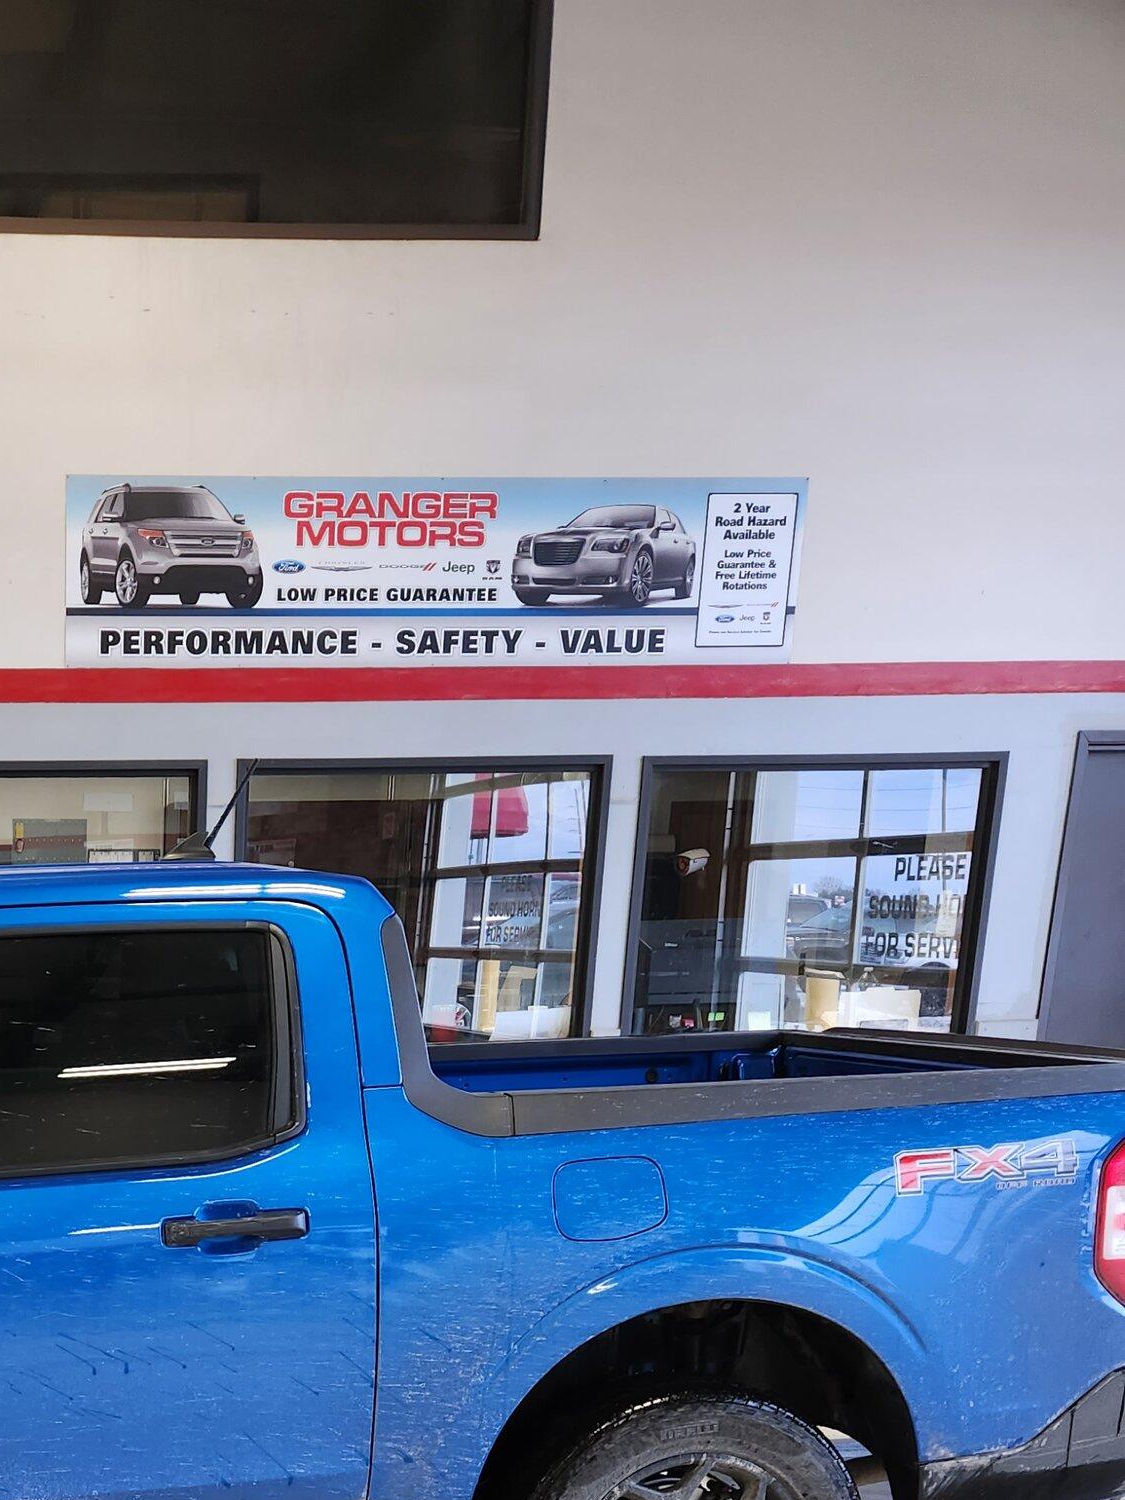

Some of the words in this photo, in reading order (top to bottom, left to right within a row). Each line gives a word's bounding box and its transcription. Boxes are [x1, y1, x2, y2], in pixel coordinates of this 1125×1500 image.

[283, 491, 498, 519] GRANGER
[733, 502, 742, 514] 2
[746, 502, 771, 514] Year
[715, 516, 744, 527] Road
[747, 516, 787, 527] Hazard
[296, 520, 485, 547] MOTORS
[723, 529, 776, 540] Available
[724, 549, 745, 558] Low
[747, 549, 772, 558] Price
[442, 561, 475, 575] Jeep
[717, 560, 765, 569] Guarantee
[768, 560, 777, 569] &
[715, 570, 735, 580] Free
[738, 570, 777, 580] Lifetime
[722, 581, 768, 591] Rotations
[276, 587, 317, 601] LOW
[325, 587, 379, 601] PRICE
[386, 587, 498, 601] GUARANTEE
[100, 630, 358, 655] PERFORMANCE
[396, 629, 523, 654] SAFETY
[560, 629, 665, 654] VALUE
[894, 854, 968, 882] PLEASE
[893, 1138, 1079, 1197] FX4
